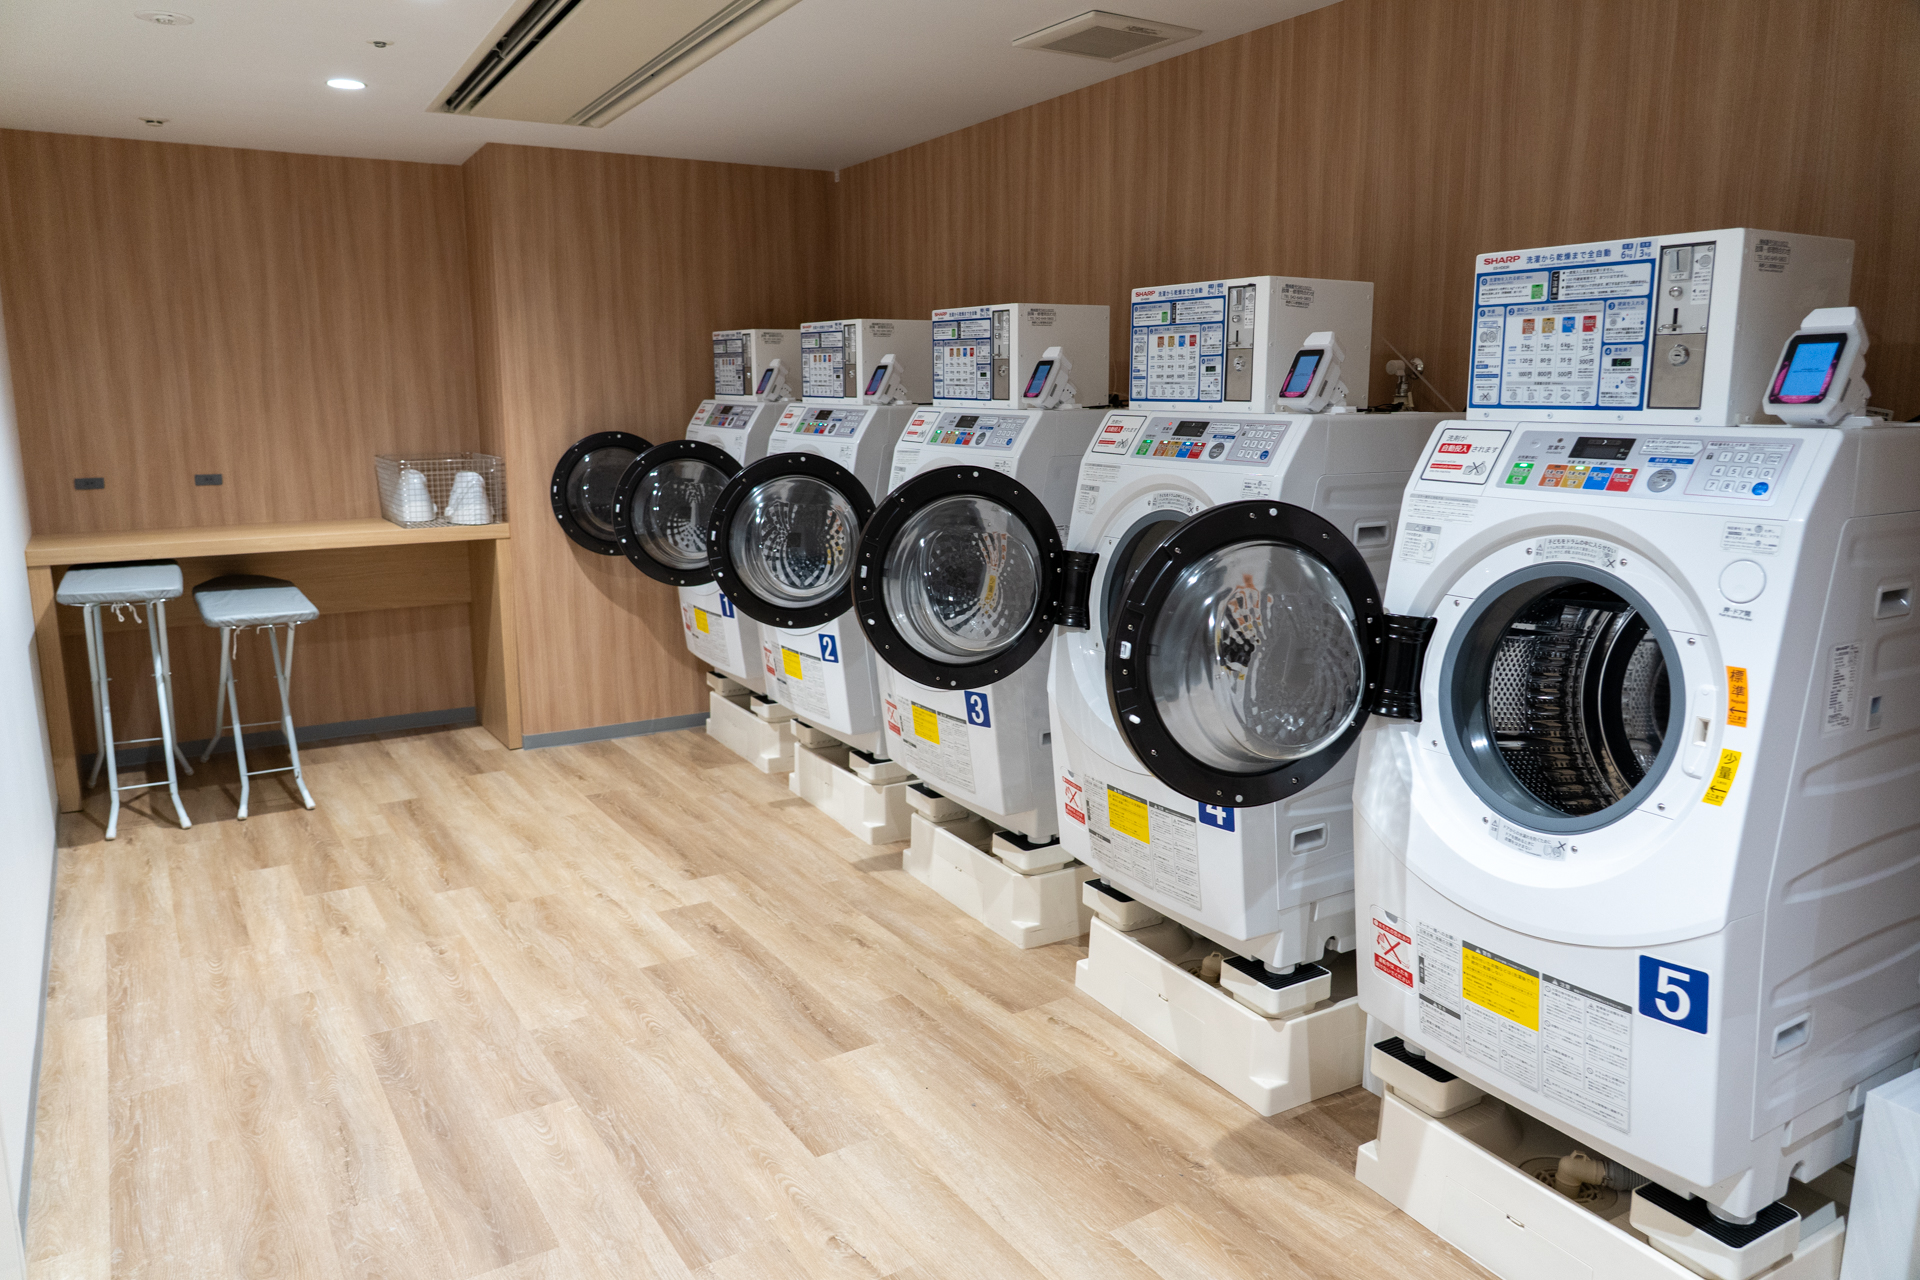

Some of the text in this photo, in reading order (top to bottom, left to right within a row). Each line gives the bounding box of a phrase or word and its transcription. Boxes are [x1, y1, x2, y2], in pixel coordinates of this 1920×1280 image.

[1484, 256, 1520, 265] SHARP
[1526, 249, 1612, 264] 洗濯から乾燥まで全自動
[1440, 444, 1467, 452] 自動投入
[1548, 539, 1617, 553] 子どもをドラムの中に入らせない
[723, 596, 730, 616] 1
[823, 636, 834, 660] 2
[1730, 670, 1746, 697] 標準
[970, 695, 984, 724] 3
[1717, 753, 1738, 780] 少量
[1706, 793, 1724, 801] ここまで
[1206, 804, 1226, 825] 4
[1655, 966, 1691, 1020] 5
